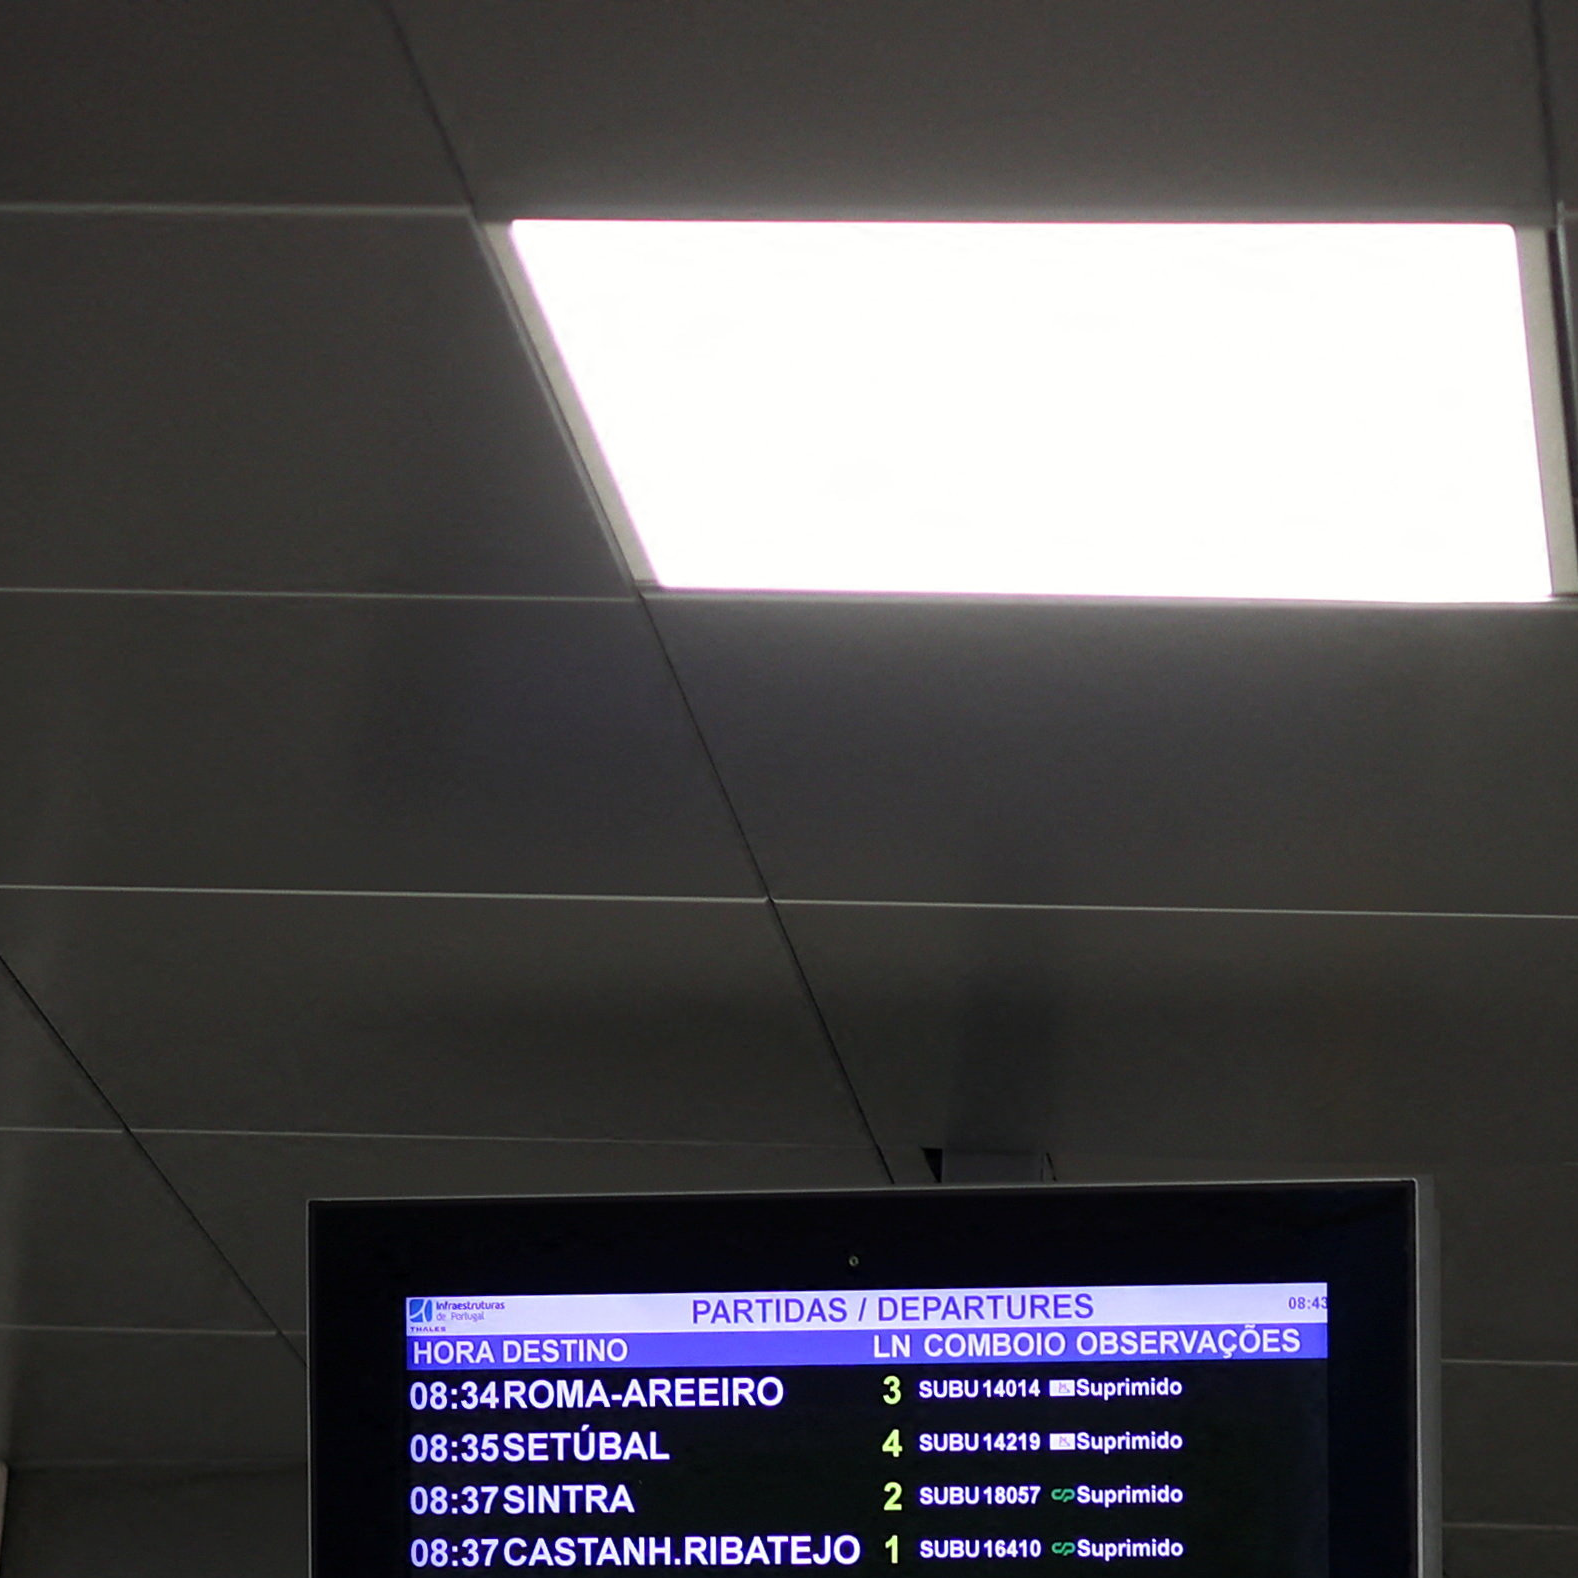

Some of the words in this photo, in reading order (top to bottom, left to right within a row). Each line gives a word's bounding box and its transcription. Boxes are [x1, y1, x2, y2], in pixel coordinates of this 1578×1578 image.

[435, 1300, 505, 1311] Infraestruturas
[435, 1311, 447, 1322] de
[450, 1310, 485, 1323] Portugal
[692, 1297, 847, 1325] PARTIDAS
[857, 1296, 867, 1323] /
[878, 1293, 1094, 1322] DEPARTURES
[1288, 1295, 1327, 1310] 08:43
[413, 1340, 495, 1365] HORA
[502, 1338, 628, 1363] DESTINO
[873, 1334, 911, 1358] LN
[923, 1331, 1066, 1358] COMBOIO
[1076, 1323, 1301, 1359] OBSERVAÇÕES
[410, 1381, 499, 1410] 08:34
[504, 1377, 783, 1408] ROMA-AREEIRO
[883, 1376, 901, 1404] 3
[919, 1380, 978, 1398] SUBU
[983, 1379, 1040, 1397] 14014
[1077, 1377, 1182, 1400] Suprimido
[411, 1434, 499, 1462] 08:35
[504, 1425, 669, 1461] SETÚBAL
[882, 1429, 902, 1457] 4
[920, 1433, 979, 1451] SUBU
[983, 1433, 1040, 1451] 14219
[1077, 1431, 1182, 1454] Suprimido
[411, 1486, 498, 1514] 08:37
[503, 1485, 634, 1514] SINTRA
[884, 1482, 902, 1510] 2
[920, 1486, 979, 1504] SUBU
[984, 1486, 1041, 1504] 18057
[1077, 1485, 1183, 1507] Suprimido
[411, 1539, 498, 1567] 08:37
[504, 1535, 860, 1566] CASTANH.RIBATEJO
[886, 1535, 898, 1563] 1
[920, 1540, 979, 1558] SUBU
[984, 1540, 1041, 1557] 16410
[1077, 1539, 1183, 1561] Suprimido
